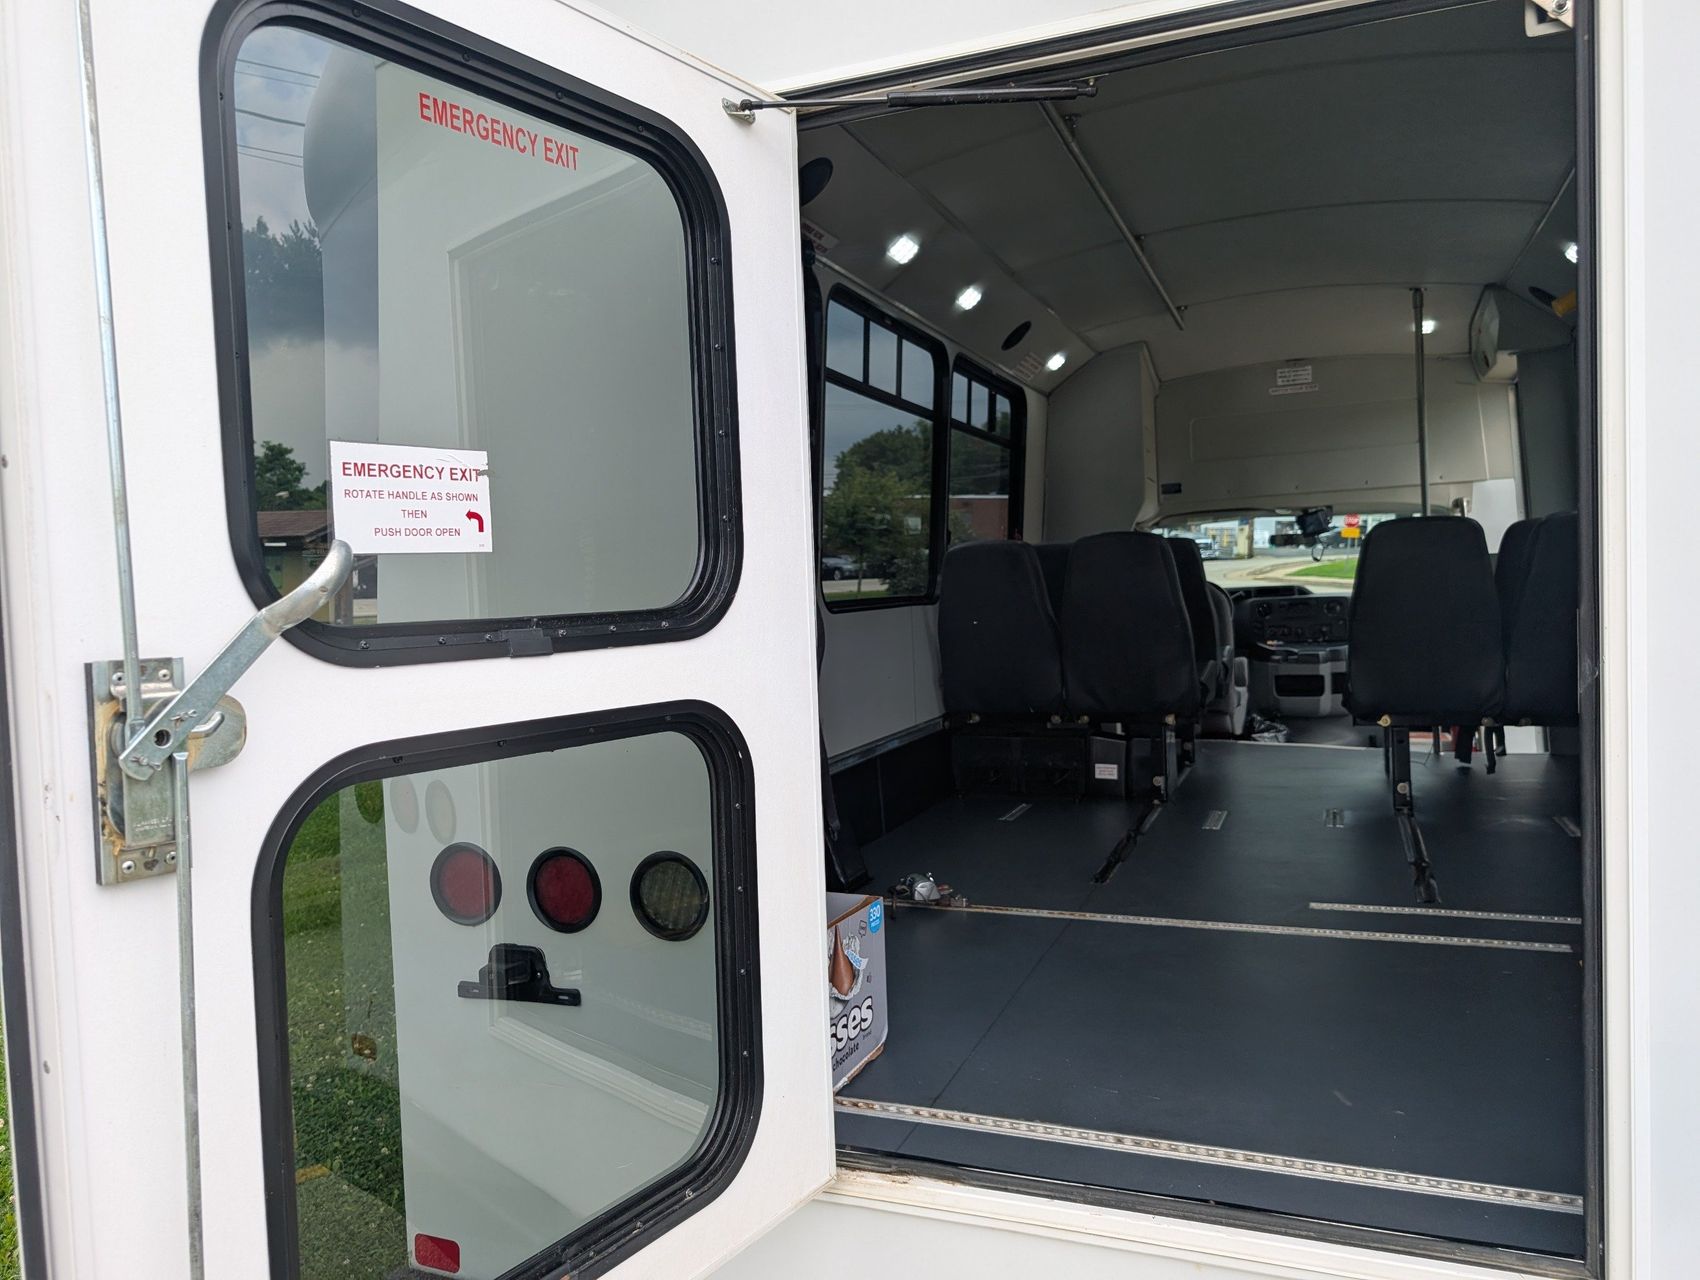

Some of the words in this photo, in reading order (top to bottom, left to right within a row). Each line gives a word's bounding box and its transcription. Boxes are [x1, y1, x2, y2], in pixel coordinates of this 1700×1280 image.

[419, 92, 538, 157] EMERGENCY
[543, 136, 579, 171] EXIT
[342, 462, 444, 481] EMERGENCY
[450, 467, 481, 482] EXIT
[344, 488, 385, 500] ROTATE
[387, 490, 428, 501] HANDLE
[430, 491, 443, 501] AS
[445, 492, 478, 502] SHOWN
[401, 509, 428, 519] THEN
[374, 527, 401, 537] PUSH
[404, 527, 433, 537] DOOR
[435, 527, 461, 537] OPEN
[869, 904, 881, 922] 330
[832, 1042, 860, 1072] chocolate
